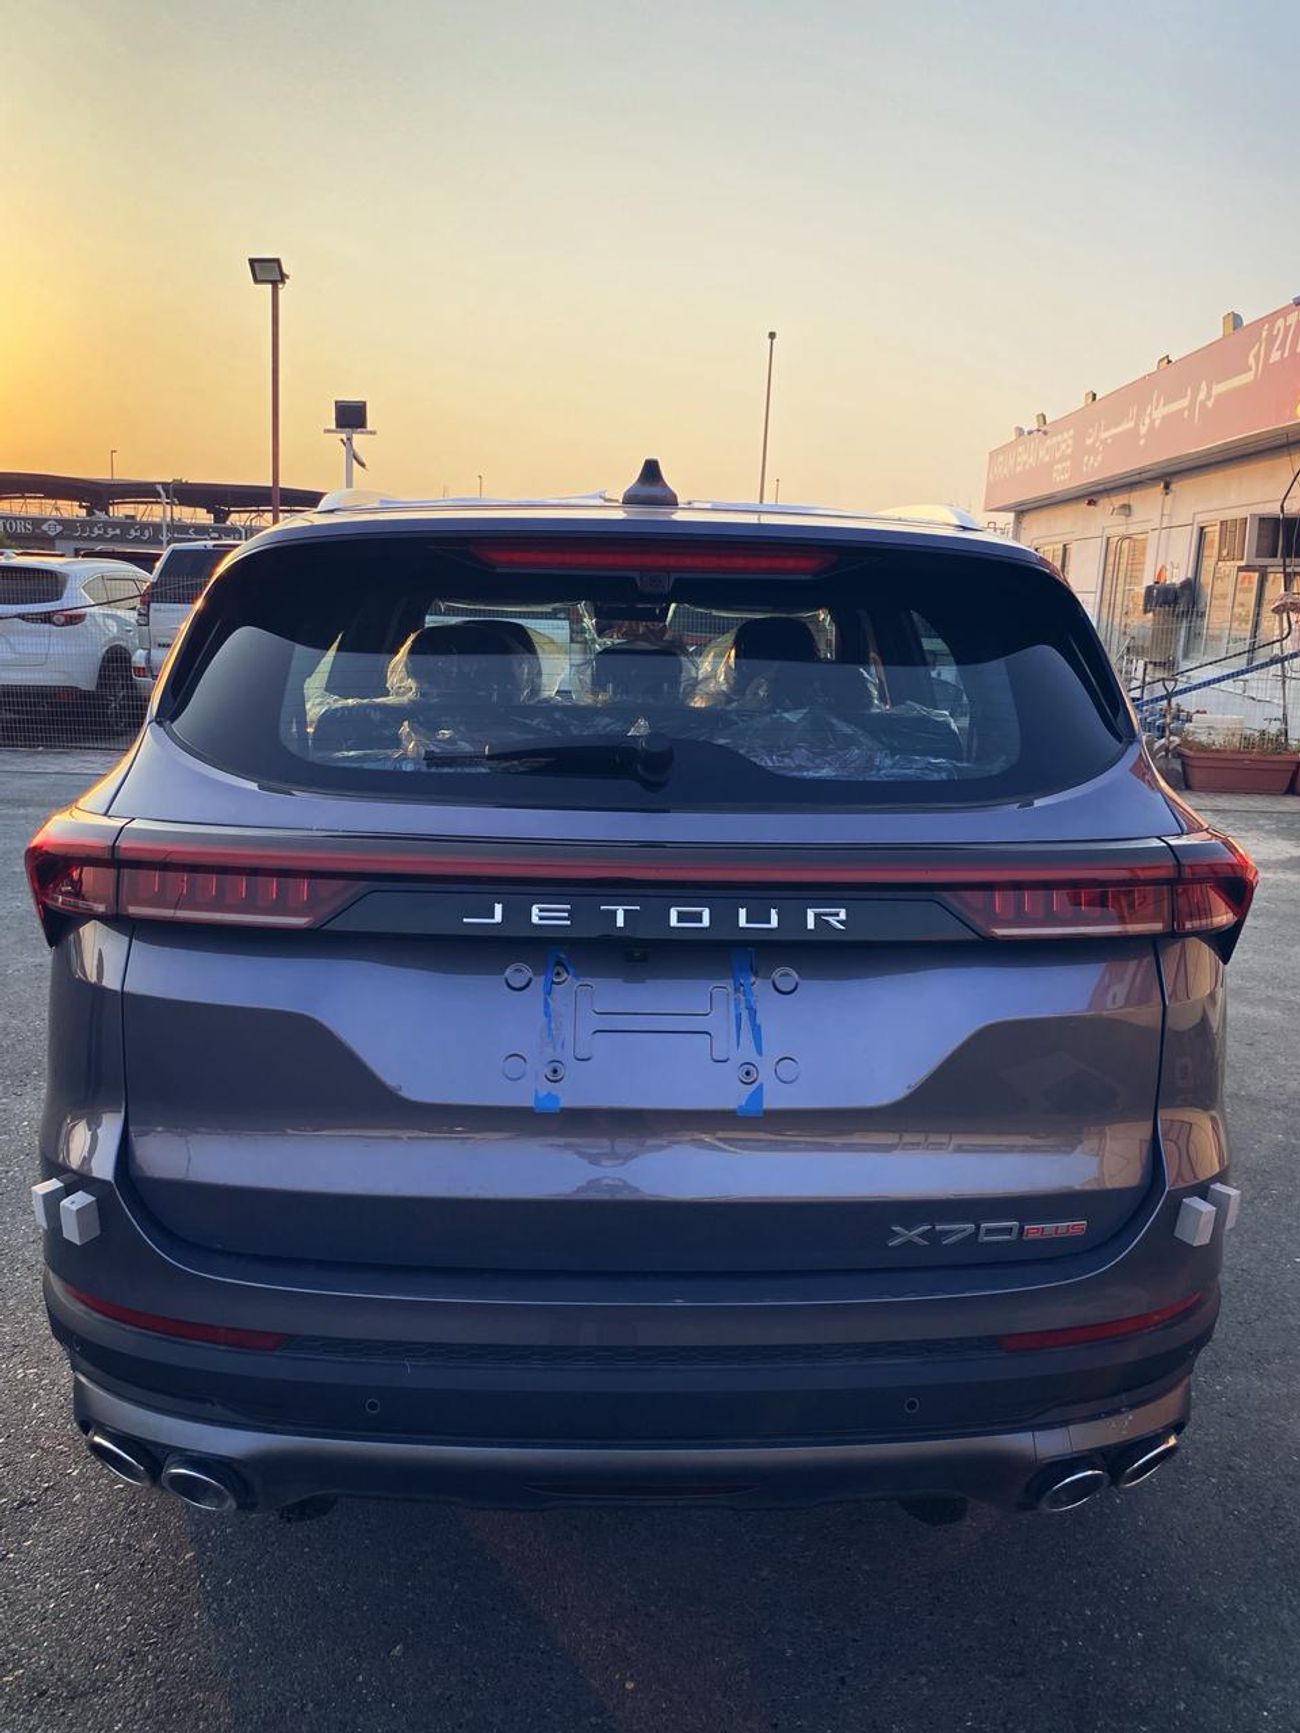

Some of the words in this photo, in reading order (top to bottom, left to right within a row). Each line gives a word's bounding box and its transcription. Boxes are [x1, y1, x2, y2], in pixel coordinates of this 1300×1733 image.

[462, 902, 848, 931] JETOUR
[887, 1221, 1019, 1247] X70
[1022, 1220, 1087, 1240] PLUS
